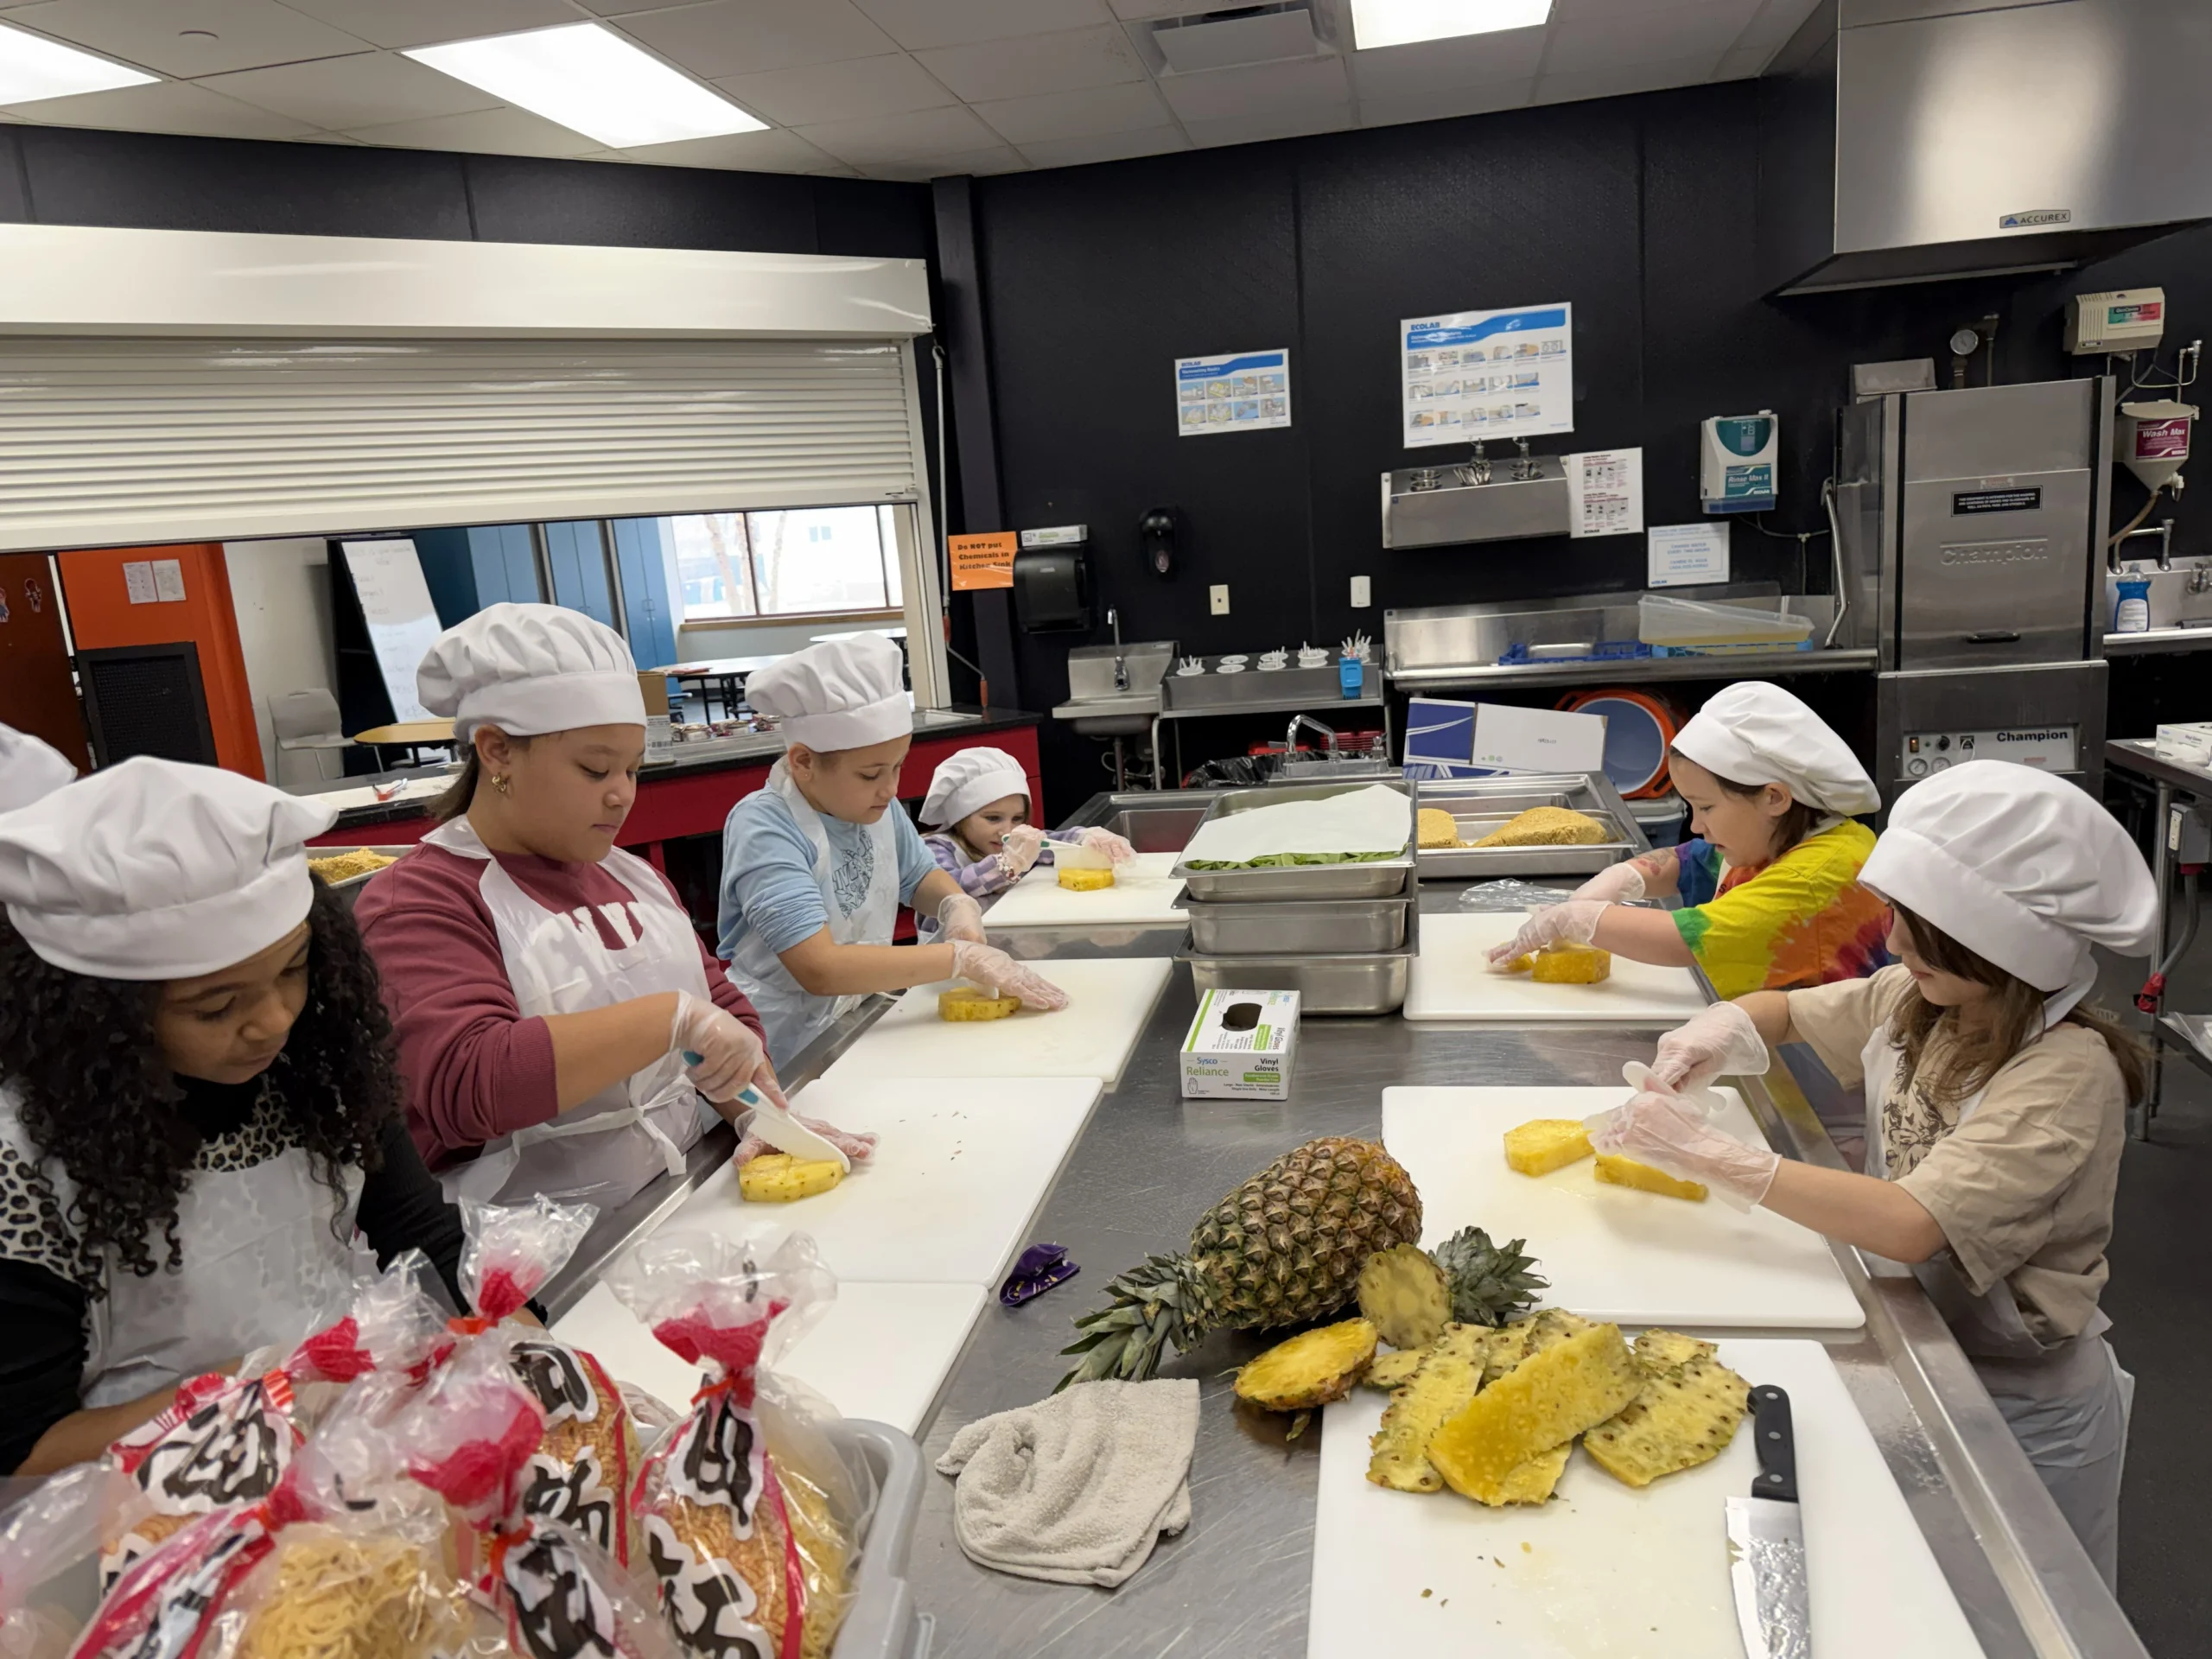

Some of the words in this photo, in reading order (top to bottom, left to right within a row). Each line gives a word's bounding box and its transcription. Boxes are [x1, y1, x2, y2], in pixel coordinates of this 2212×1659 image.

[2020, 213, 2067, 224] ACCUREX
[2143, 429, 2168, 438] Wash
[958, 551, 999, 560] Chemicals
[1940, 544, 2048, 565] Champion
[1997, 730, 2068, 742] Champion
[1197, 1057, 1217, 1065] Sysco
[1186, 1066, 1229, 1077] Reliance
